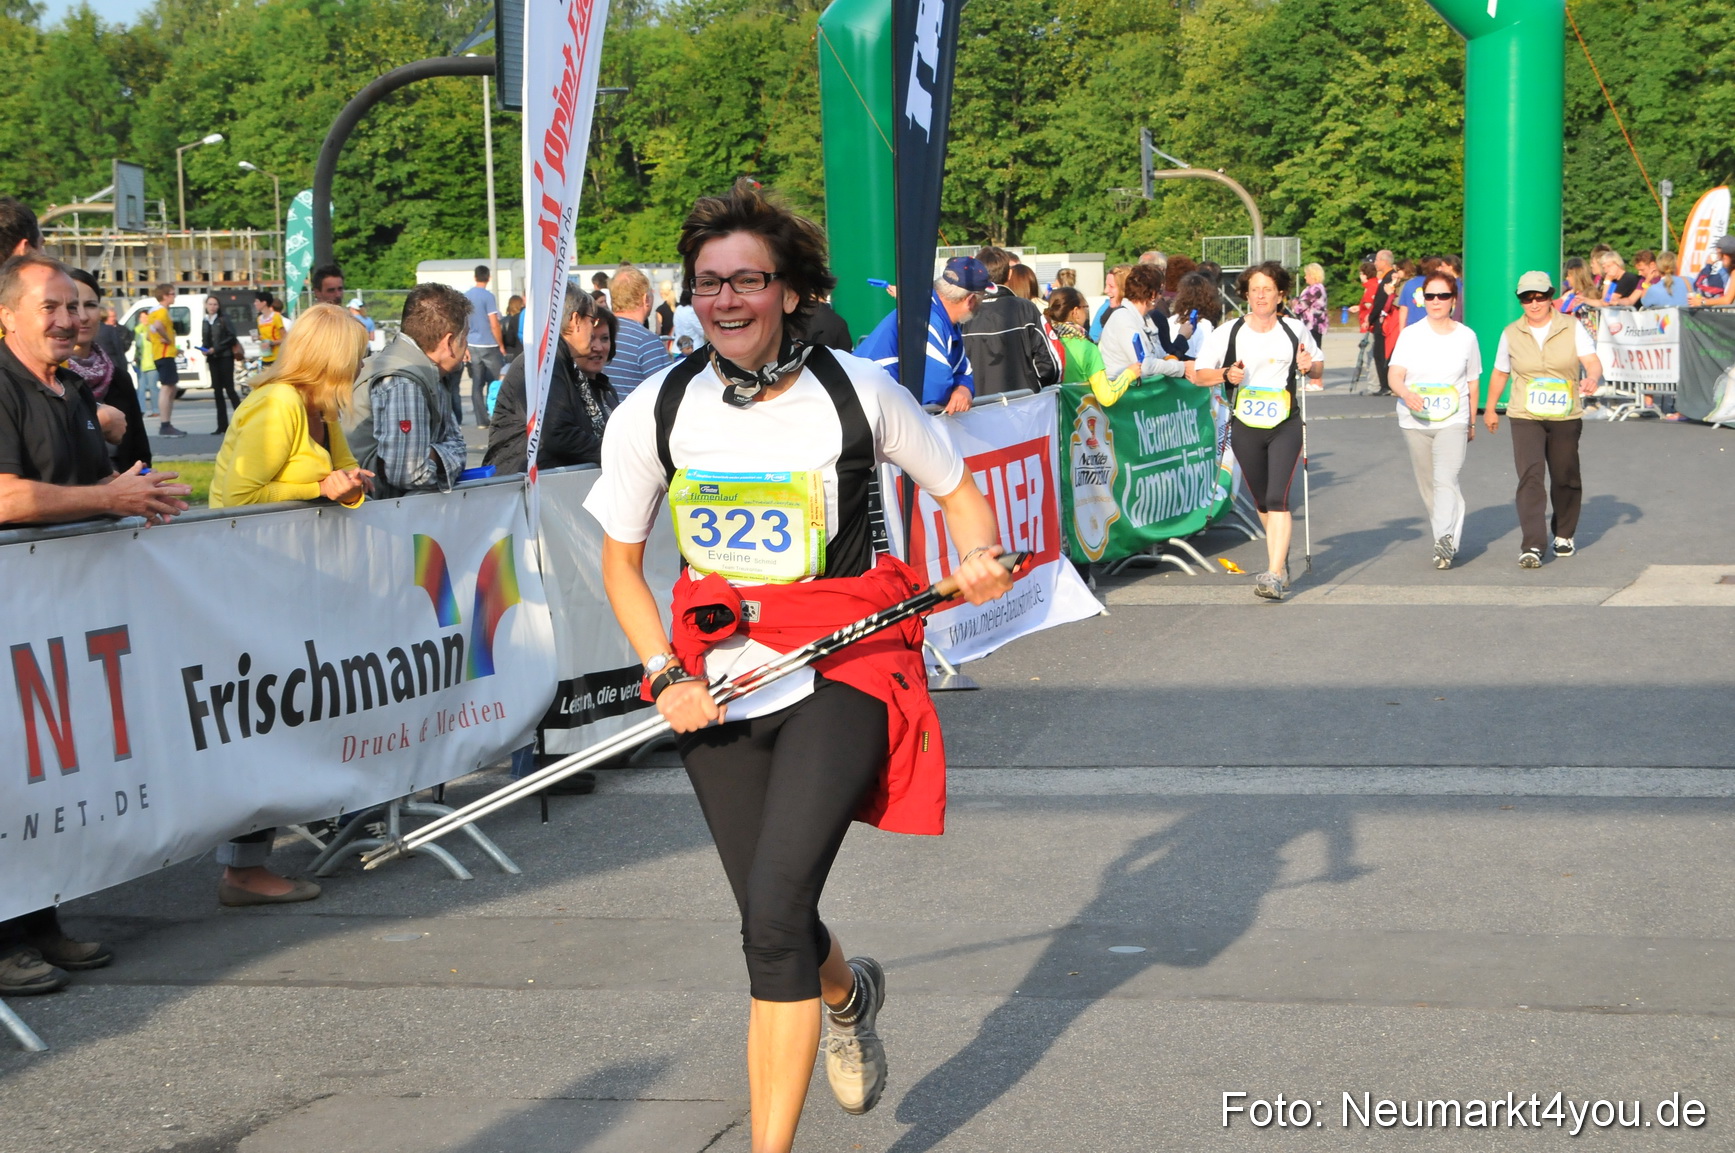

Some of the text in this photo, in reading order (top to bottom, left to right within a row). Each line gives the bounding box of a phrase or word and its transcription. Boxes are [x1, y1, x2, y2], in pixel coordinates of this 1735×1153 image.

[1423, 396, 1451, 410] 043
[1529, 391, 1567, 406] 1044
[1242, 400, 1278, 418] 326
[1133, 399, 1200, 457] Neumarkter
[690, 492, 738, 502] firmenlauf
[1121, 447, 1227, 529] Lammsbräu
[689, 507, 792, 553] 323
[708, 550, 751, 563] Eveline
[180, 632, 465, 752] Frischmann
[597, 686, 617, 705] die
[341, 722, 410, 763] Druck
[434, 699, 506, 737] Medien
